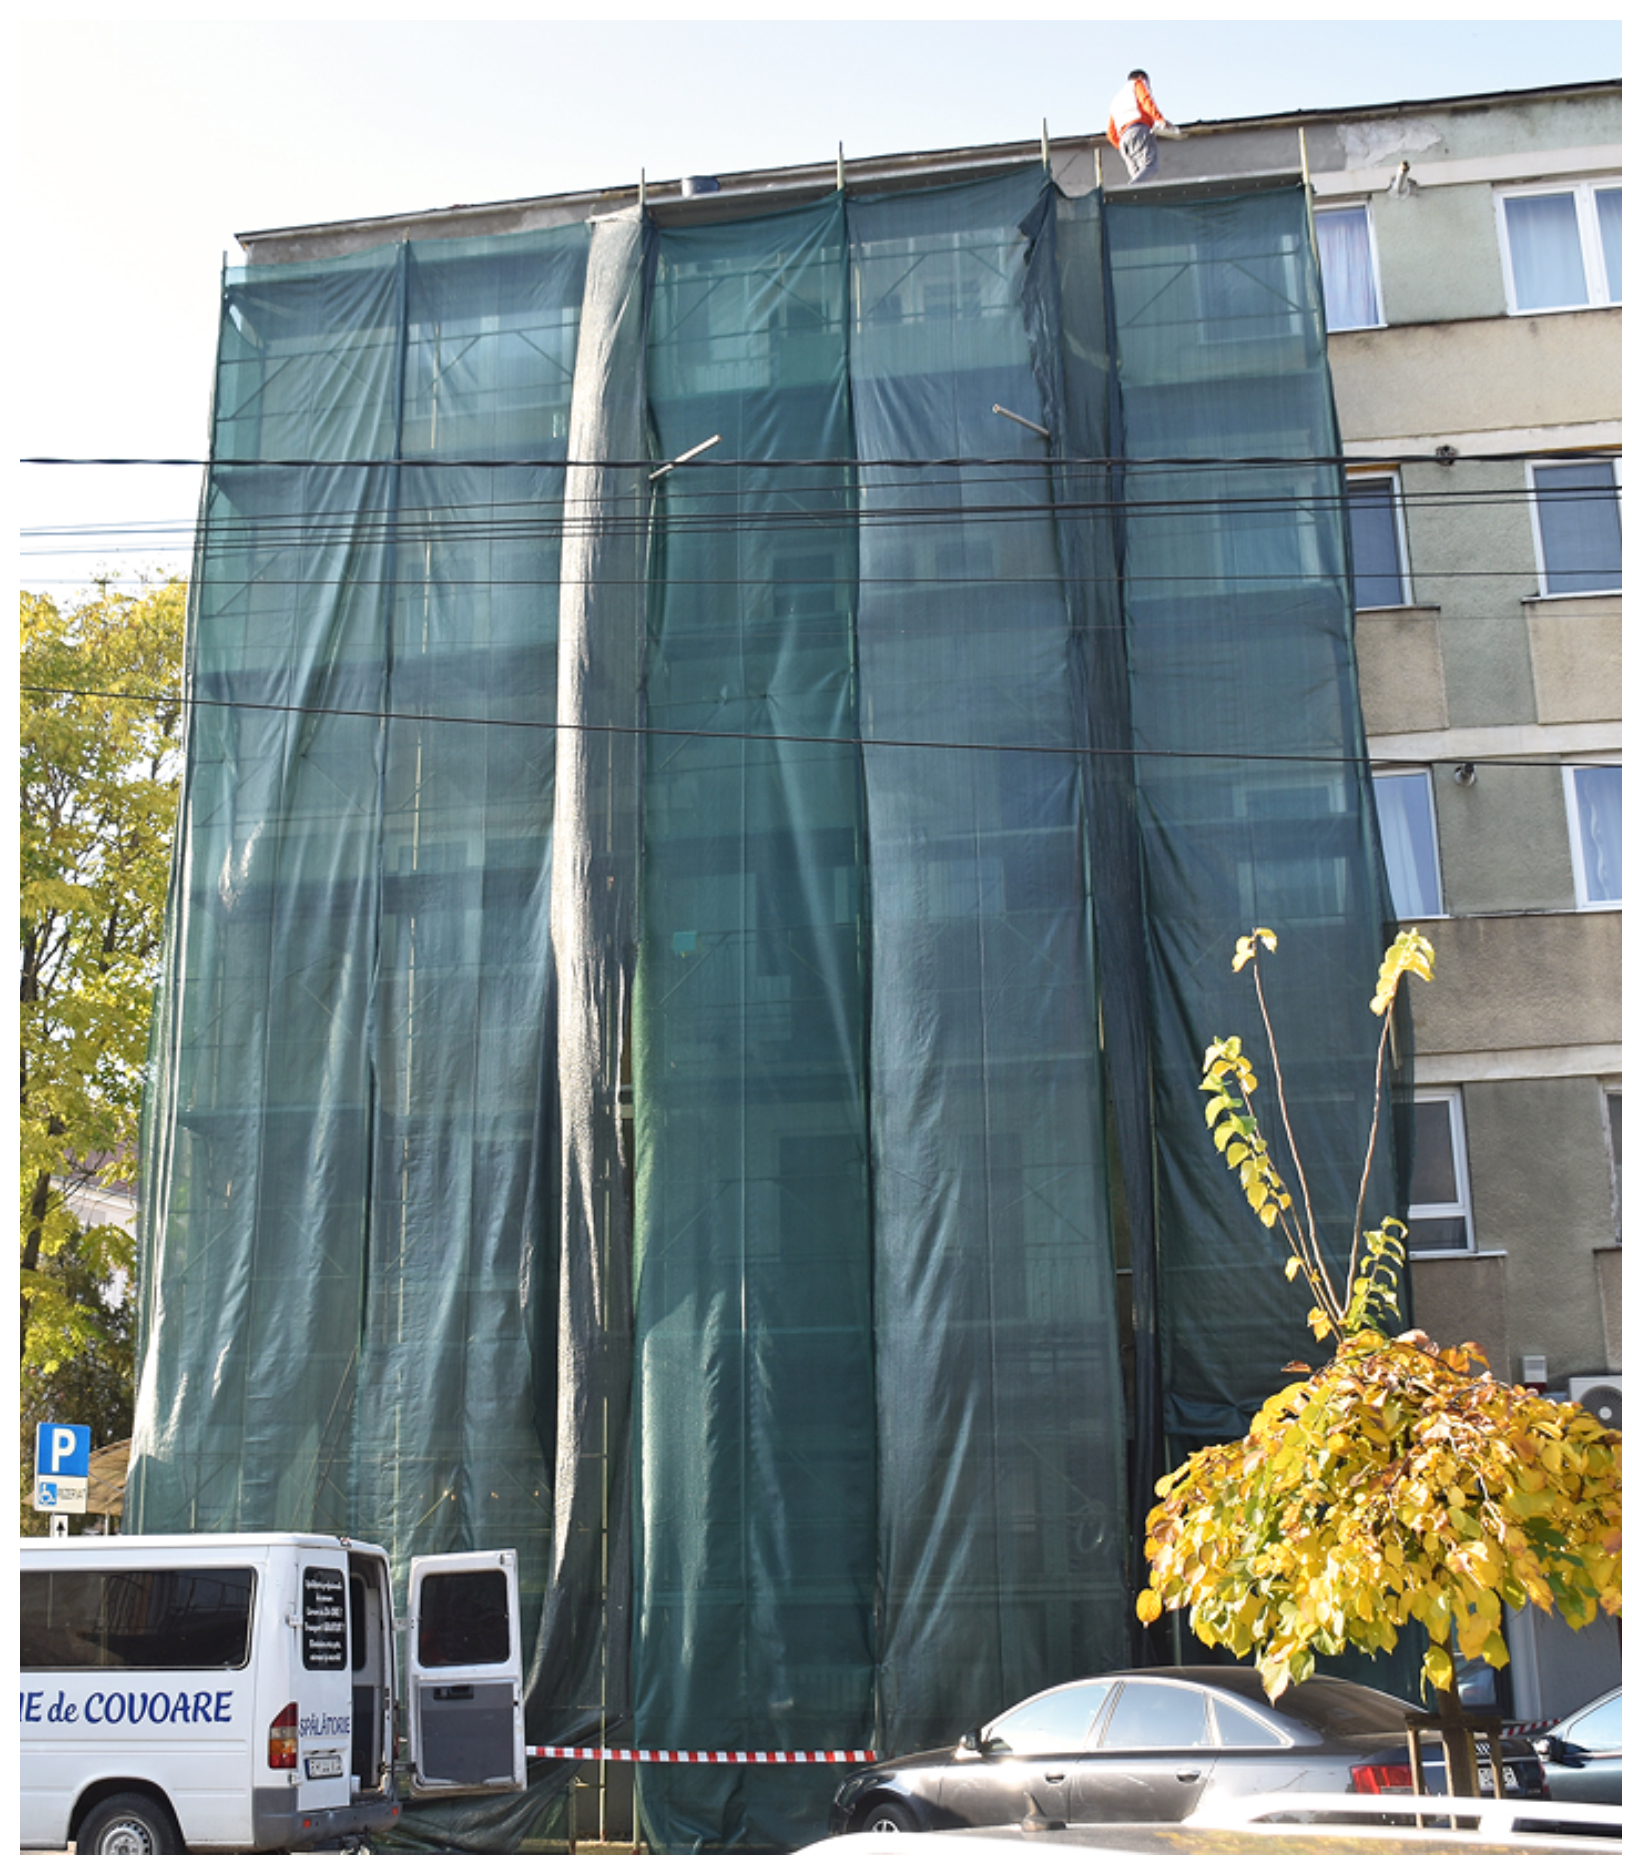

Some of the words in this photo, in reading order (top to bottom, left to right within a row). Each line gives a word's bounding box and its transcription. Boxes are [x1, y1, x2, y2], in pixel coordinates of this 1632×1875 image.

[51, 1427, 77, 1473] P
[47, 1689, 79, 1724] de
[84, 1690, 235, 1725] COVOARE
